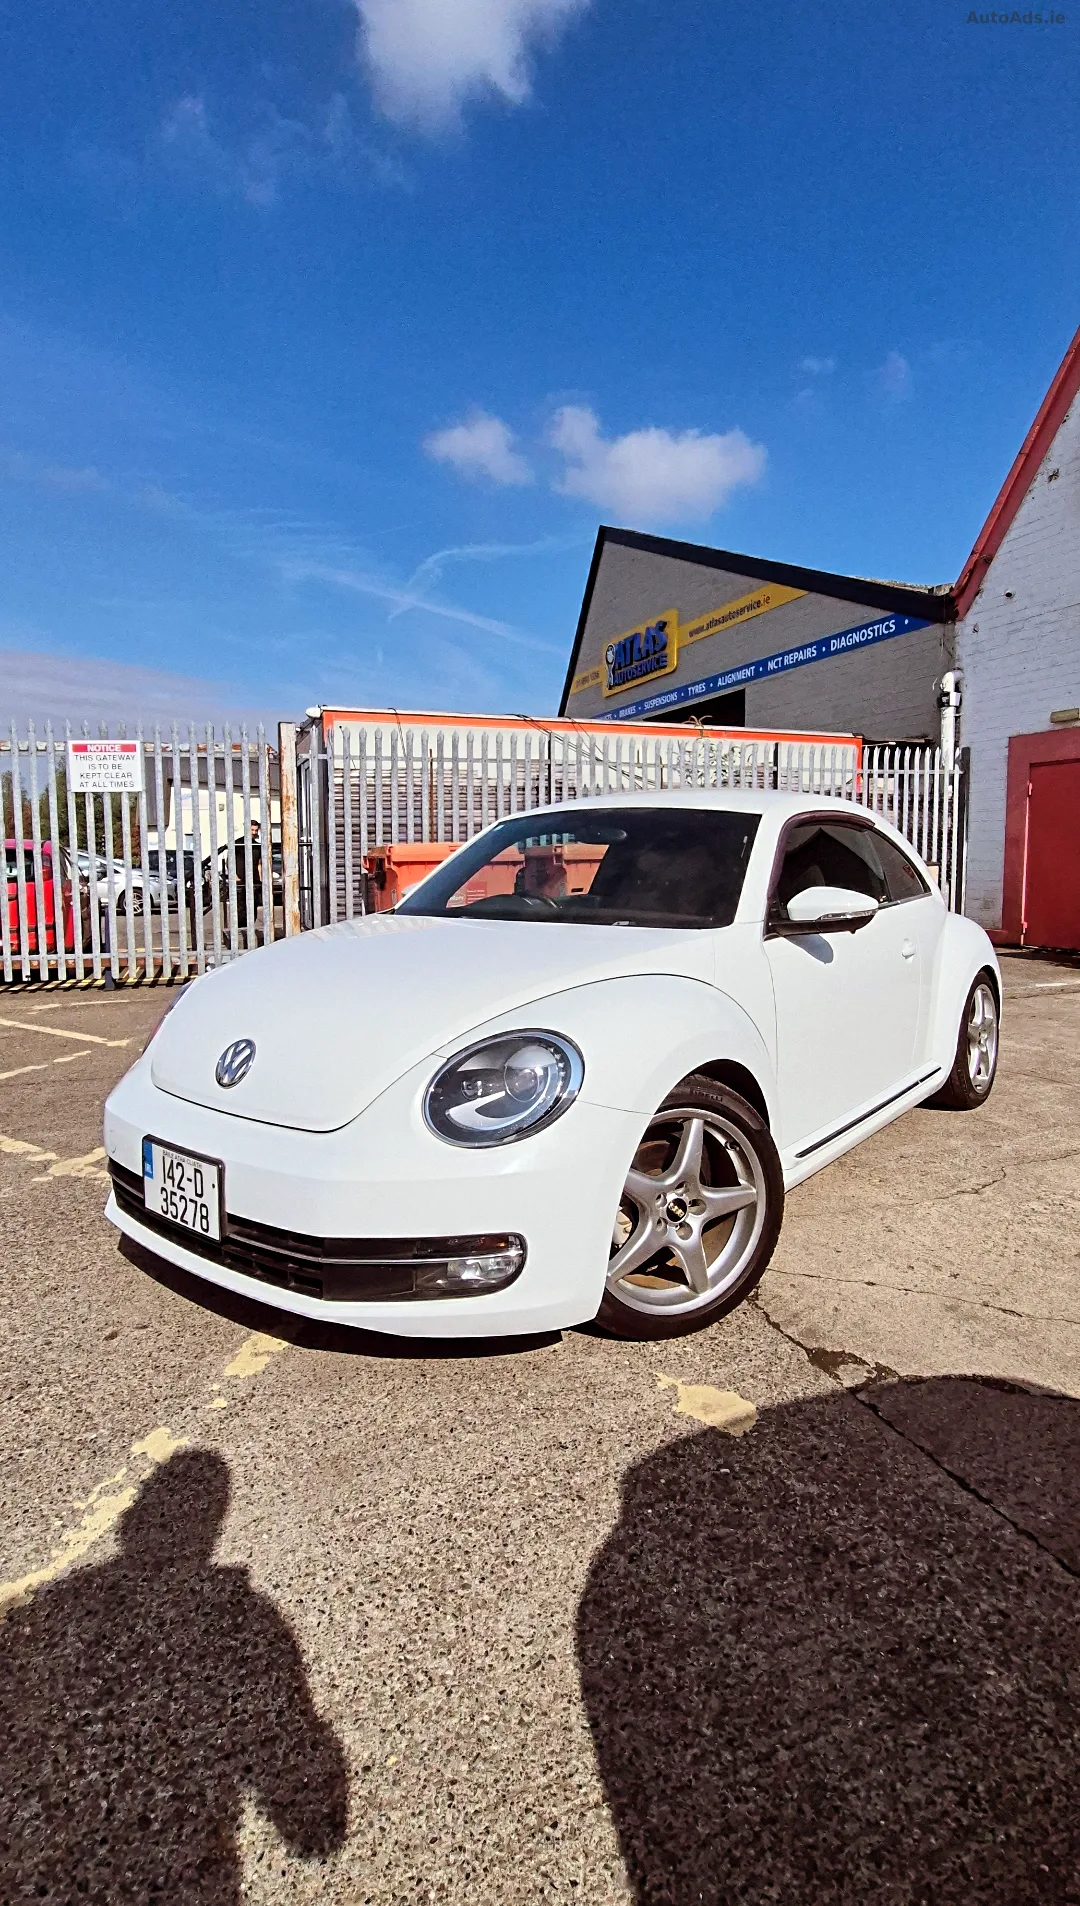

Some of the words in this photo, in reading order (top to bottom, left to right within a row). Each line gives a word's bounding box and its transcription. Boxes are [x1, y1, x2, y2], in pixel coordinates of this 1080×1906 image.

[688, 594, 771, 638] www.atlasautoservice.ie
[615, 620, 668, 671] ATLAS
[643, 691, 678, 710] SUSPENSIONS
[687, 682, 707, 697] TYRES
[717, 666, 756, 687] ALIGNMENT
[767, 657, 783, 672] NCT
[783, 645, 817, 666] REPAIRS
[830, 619, 896, 652] DIAGNOSTICS
[613, 652, 668, 688] AUTOSERVICE
[86, 744, 122, 752] NOTICE
[162, 1155, 204, 1199] 142-D
[160, 1186, 210, 1234] 35278
